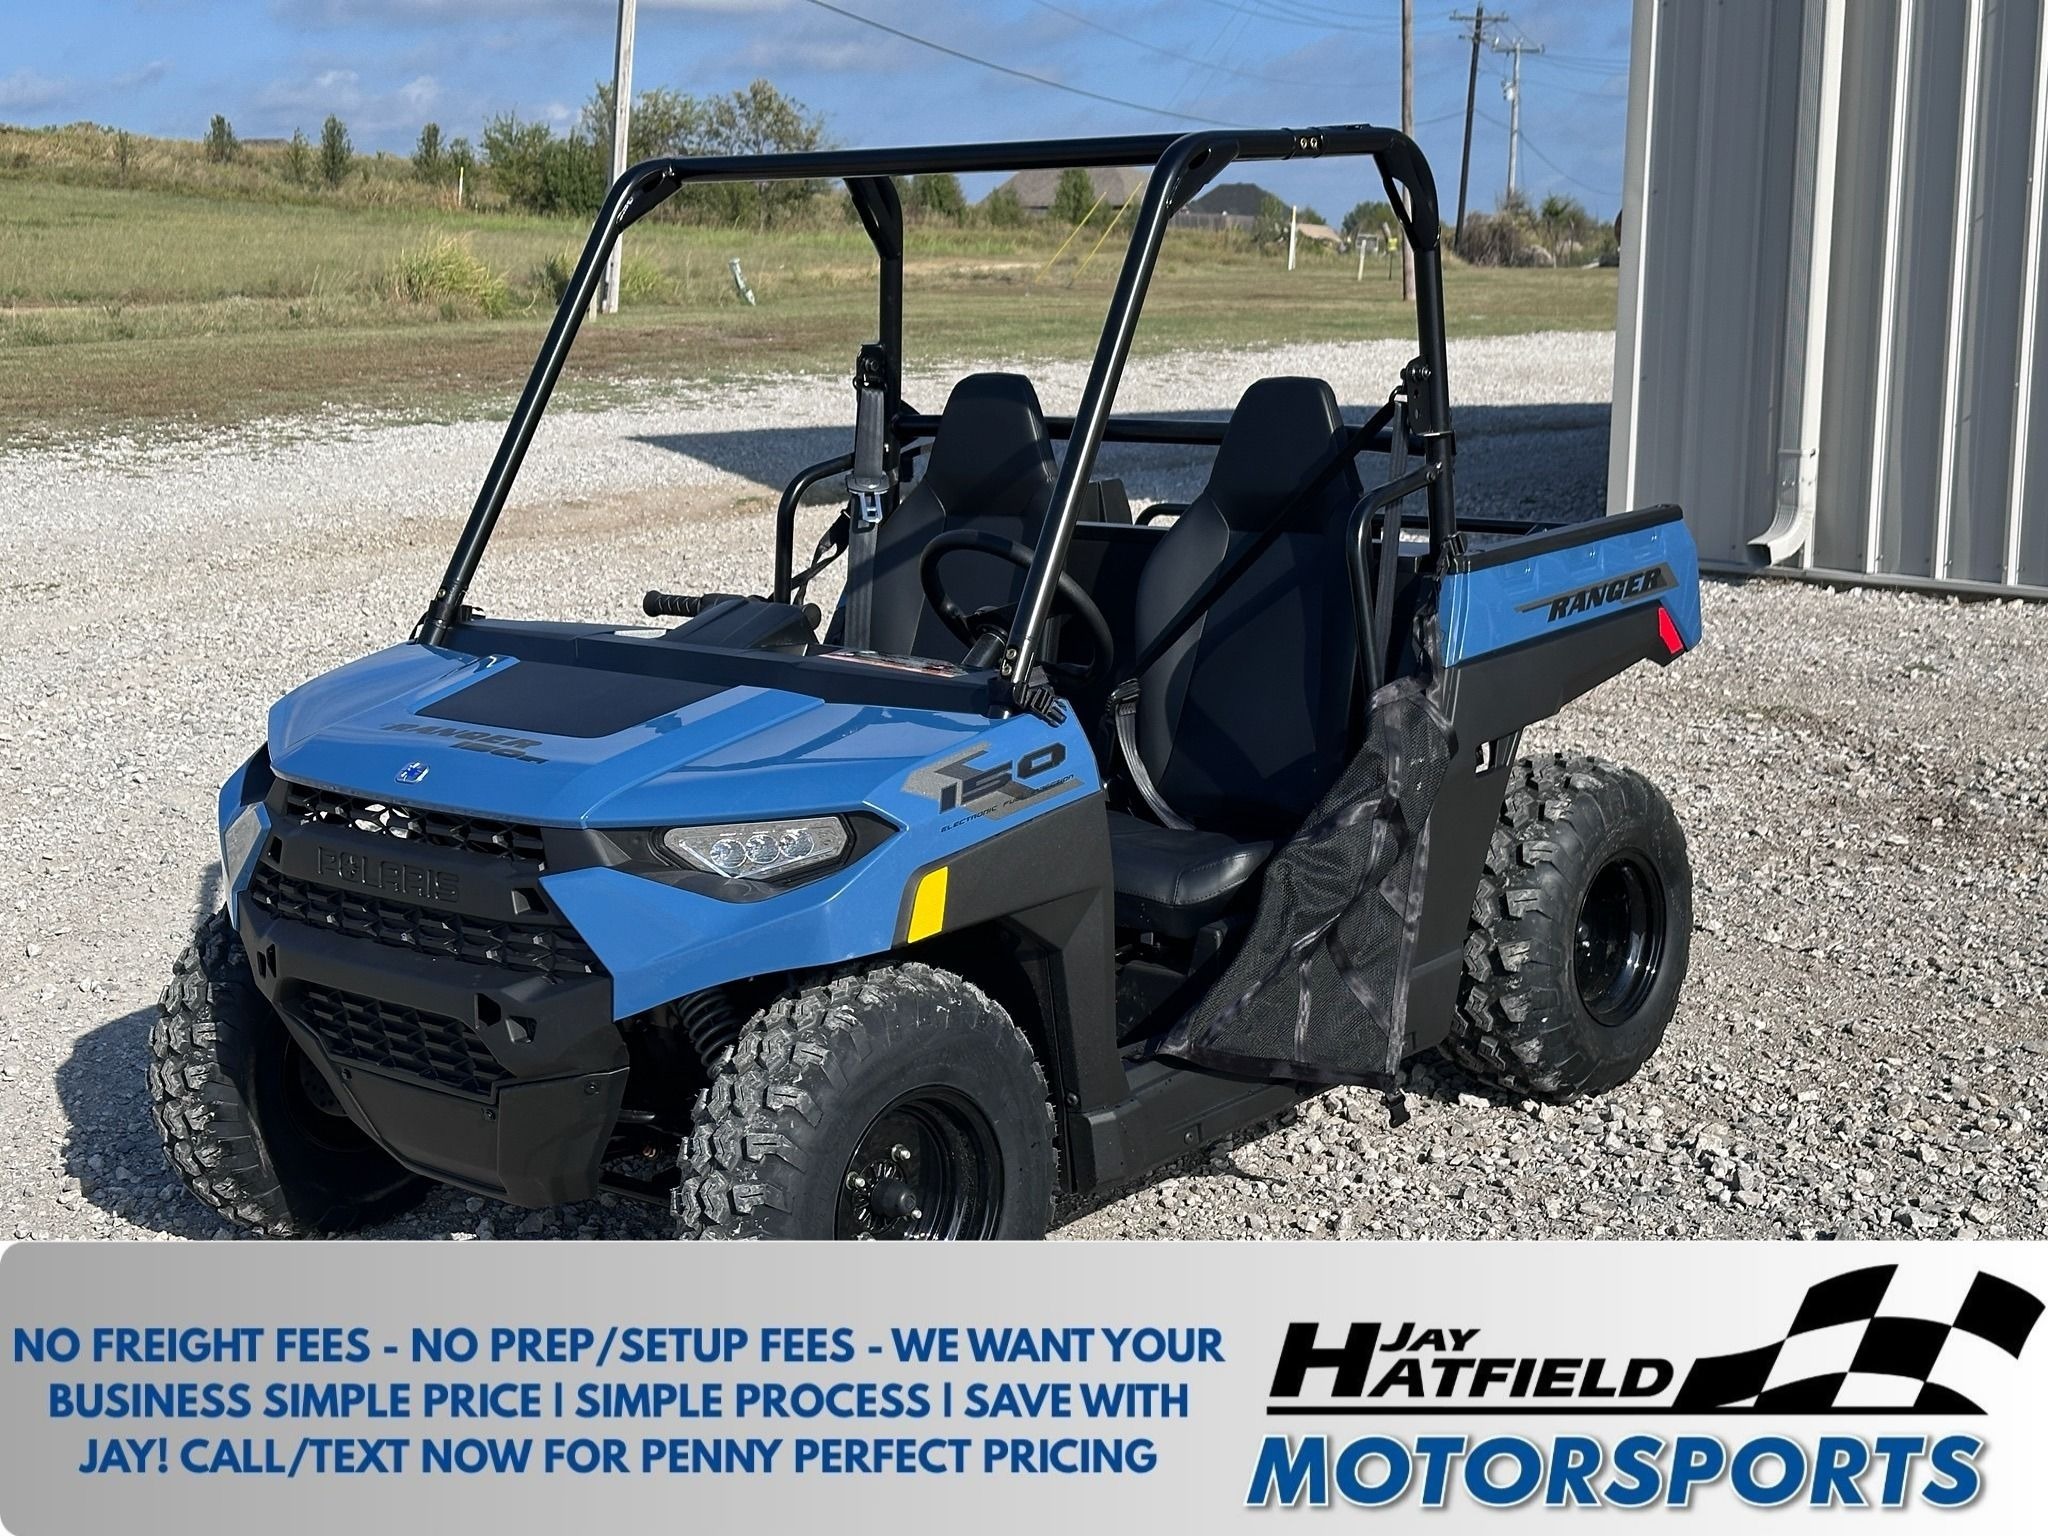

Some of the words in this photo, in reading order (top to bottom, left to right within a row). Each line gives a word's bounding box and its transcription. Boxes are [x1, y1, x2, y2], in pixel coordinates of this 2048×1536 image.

[1547, 567, 1663, 623] RANGER
[939, 742, 1067, 814] 150
[317, 846, 459, 902] POLARIS
